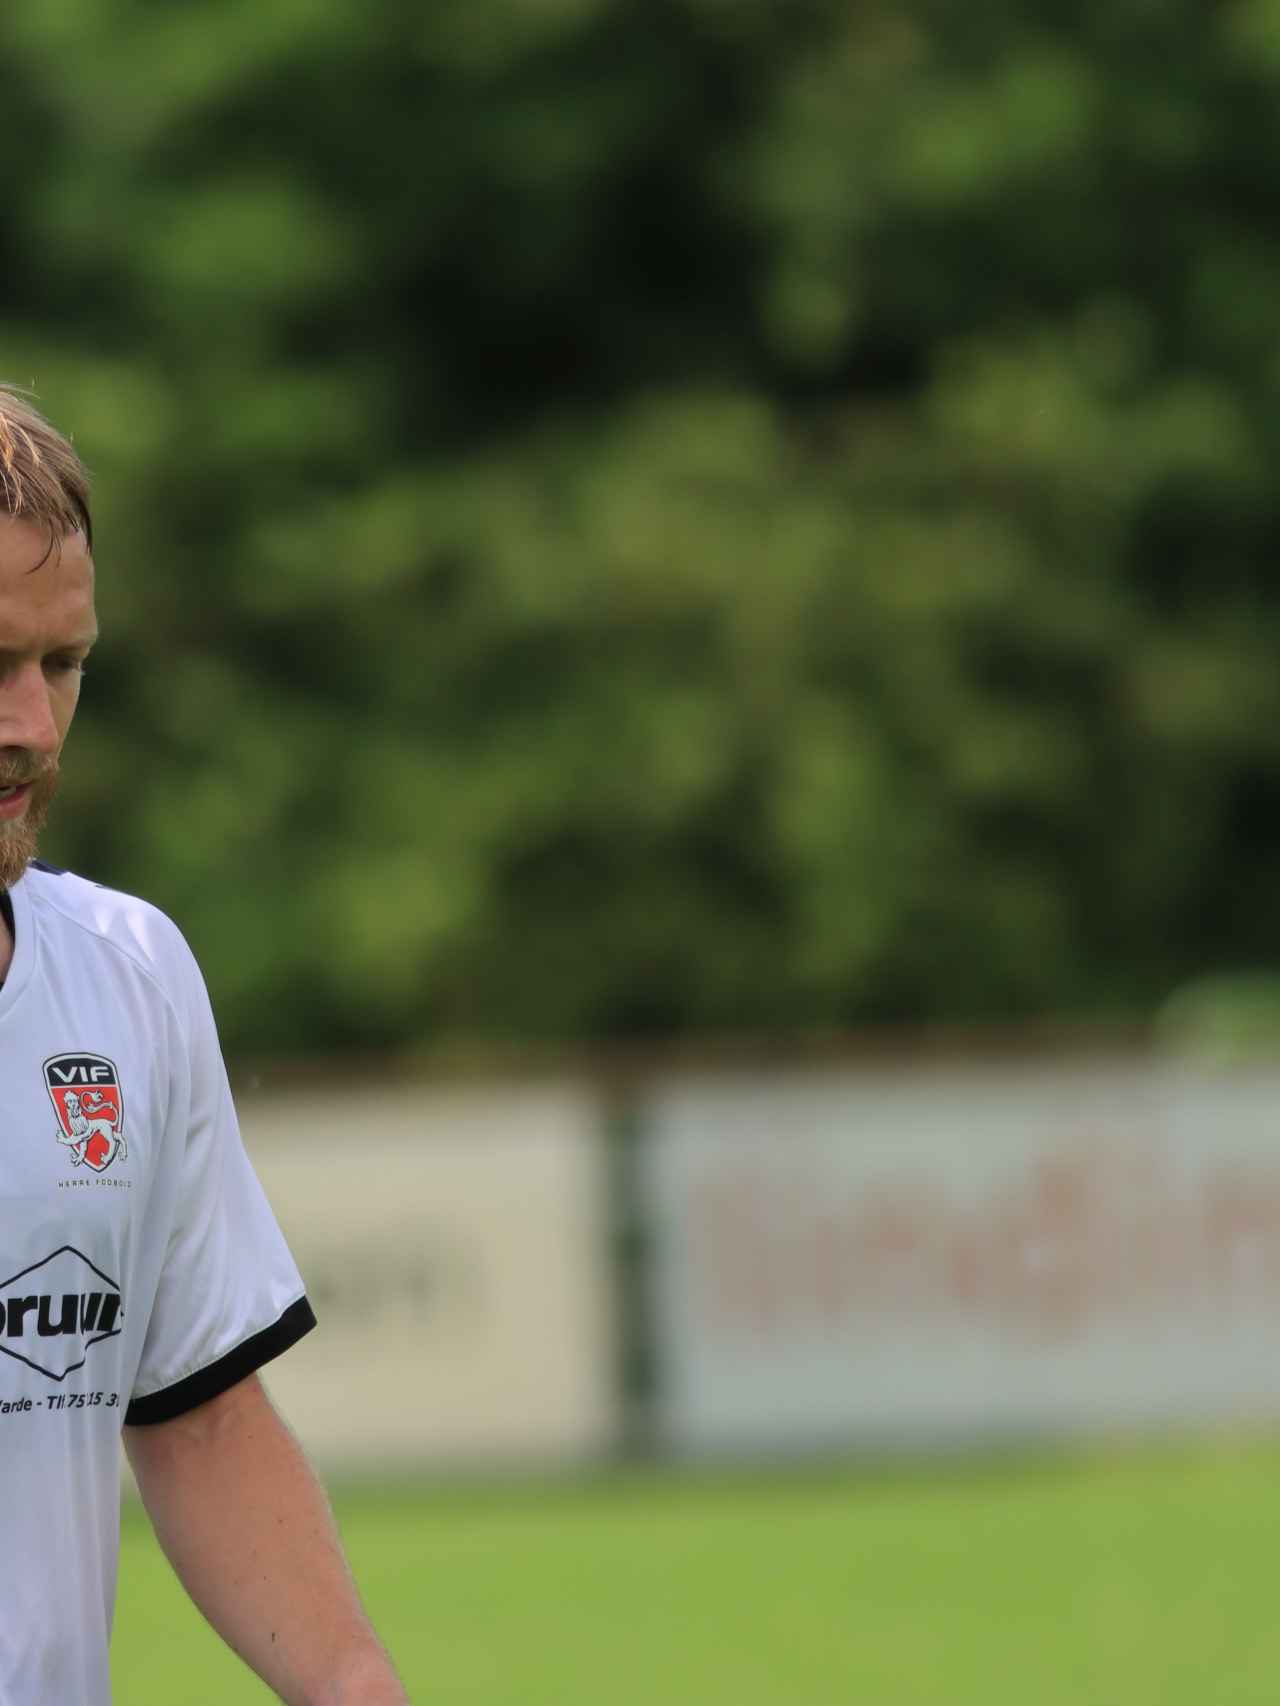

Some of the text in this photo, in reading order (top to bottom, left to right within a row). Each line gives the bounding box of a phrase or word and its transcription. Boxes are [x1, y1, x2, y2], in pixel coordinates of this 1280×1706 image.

[51, 1066, 110, 1083] VIF
[67, 1394, 86, 1409] 75
[87, 1392, 104, 1407] 15
